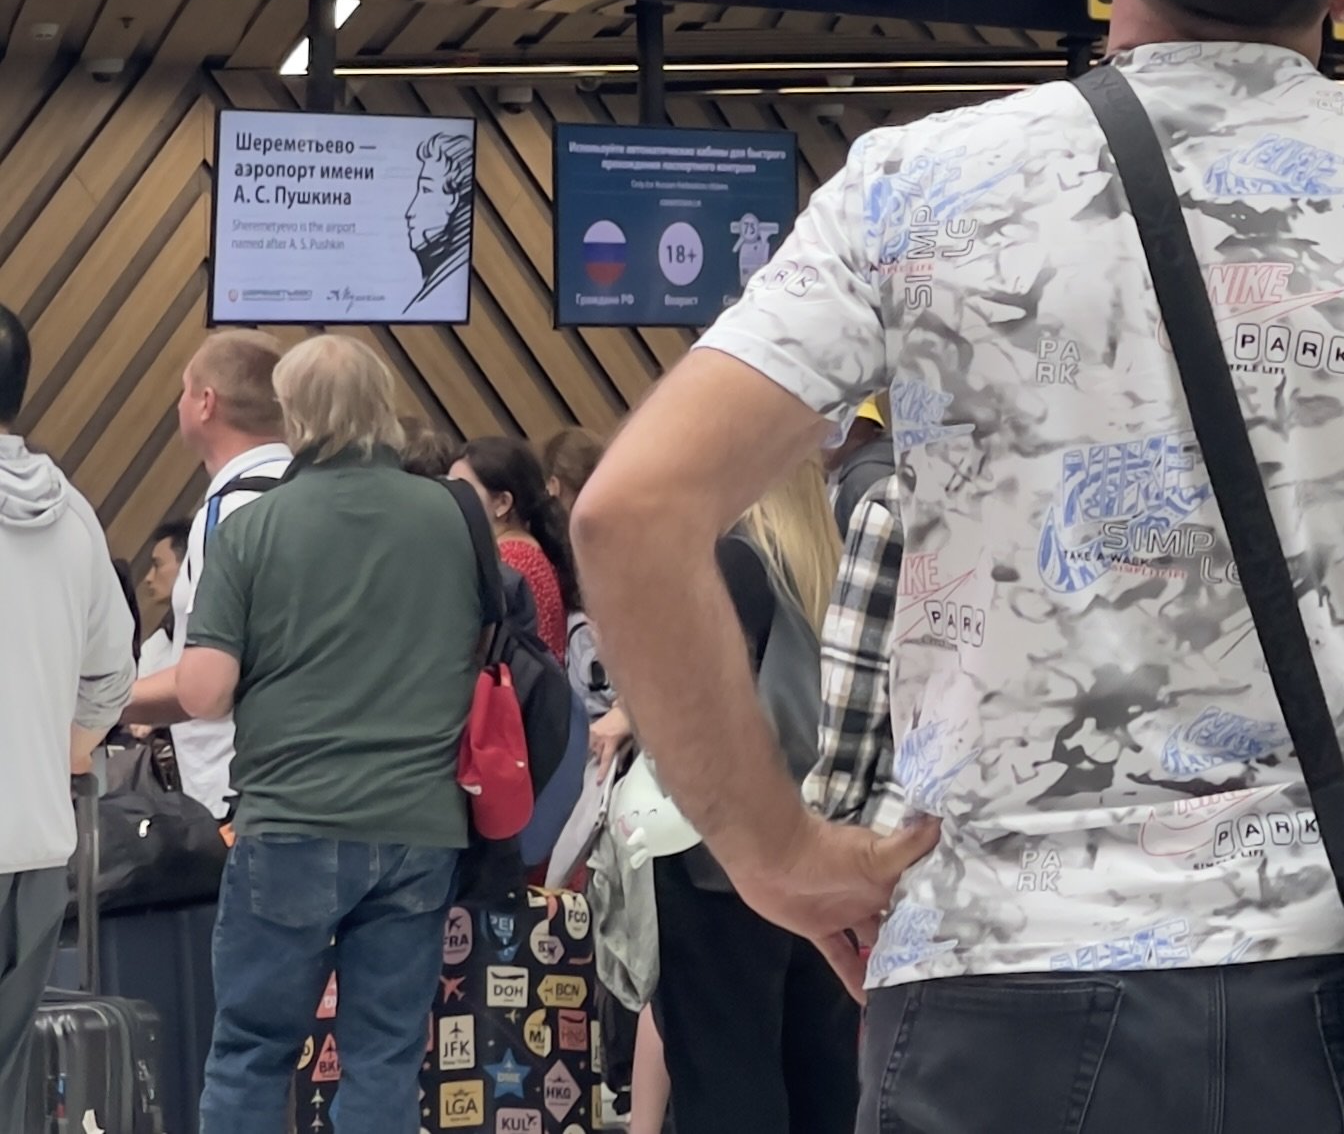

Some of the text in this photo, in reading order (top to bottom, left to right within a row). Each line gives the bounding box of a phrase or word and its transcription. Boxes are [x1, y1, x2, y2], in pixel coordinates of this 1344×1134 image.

[235, 131, 355, 155] Шереметьево
[234, 162, 375, 184] аэропорт имени
[233, 185, 352, 209] А. С. Пушкина
[231, 219, 297, 235] Sheremetyevo
[326, 221, 356, 236] airport
[231, 239, 264, 250] named
[265, 238, 287, 250] after
[310, 239, 345, 251] Pushkin
[666, 244, 697, 264] 18+
[898, 552, 941, 597] IKE
[492, 984, 524, 997] DOH
[555, 983, 581, 997] BCN
[529, 1029, 546, 1042] MA
[443, 1040, 471, 1058] JFK
[318, 1061, 341, 1074] BK
[445, 1098, 479, 1117] LGA
[501, 1119, 530, 1132] KUL
